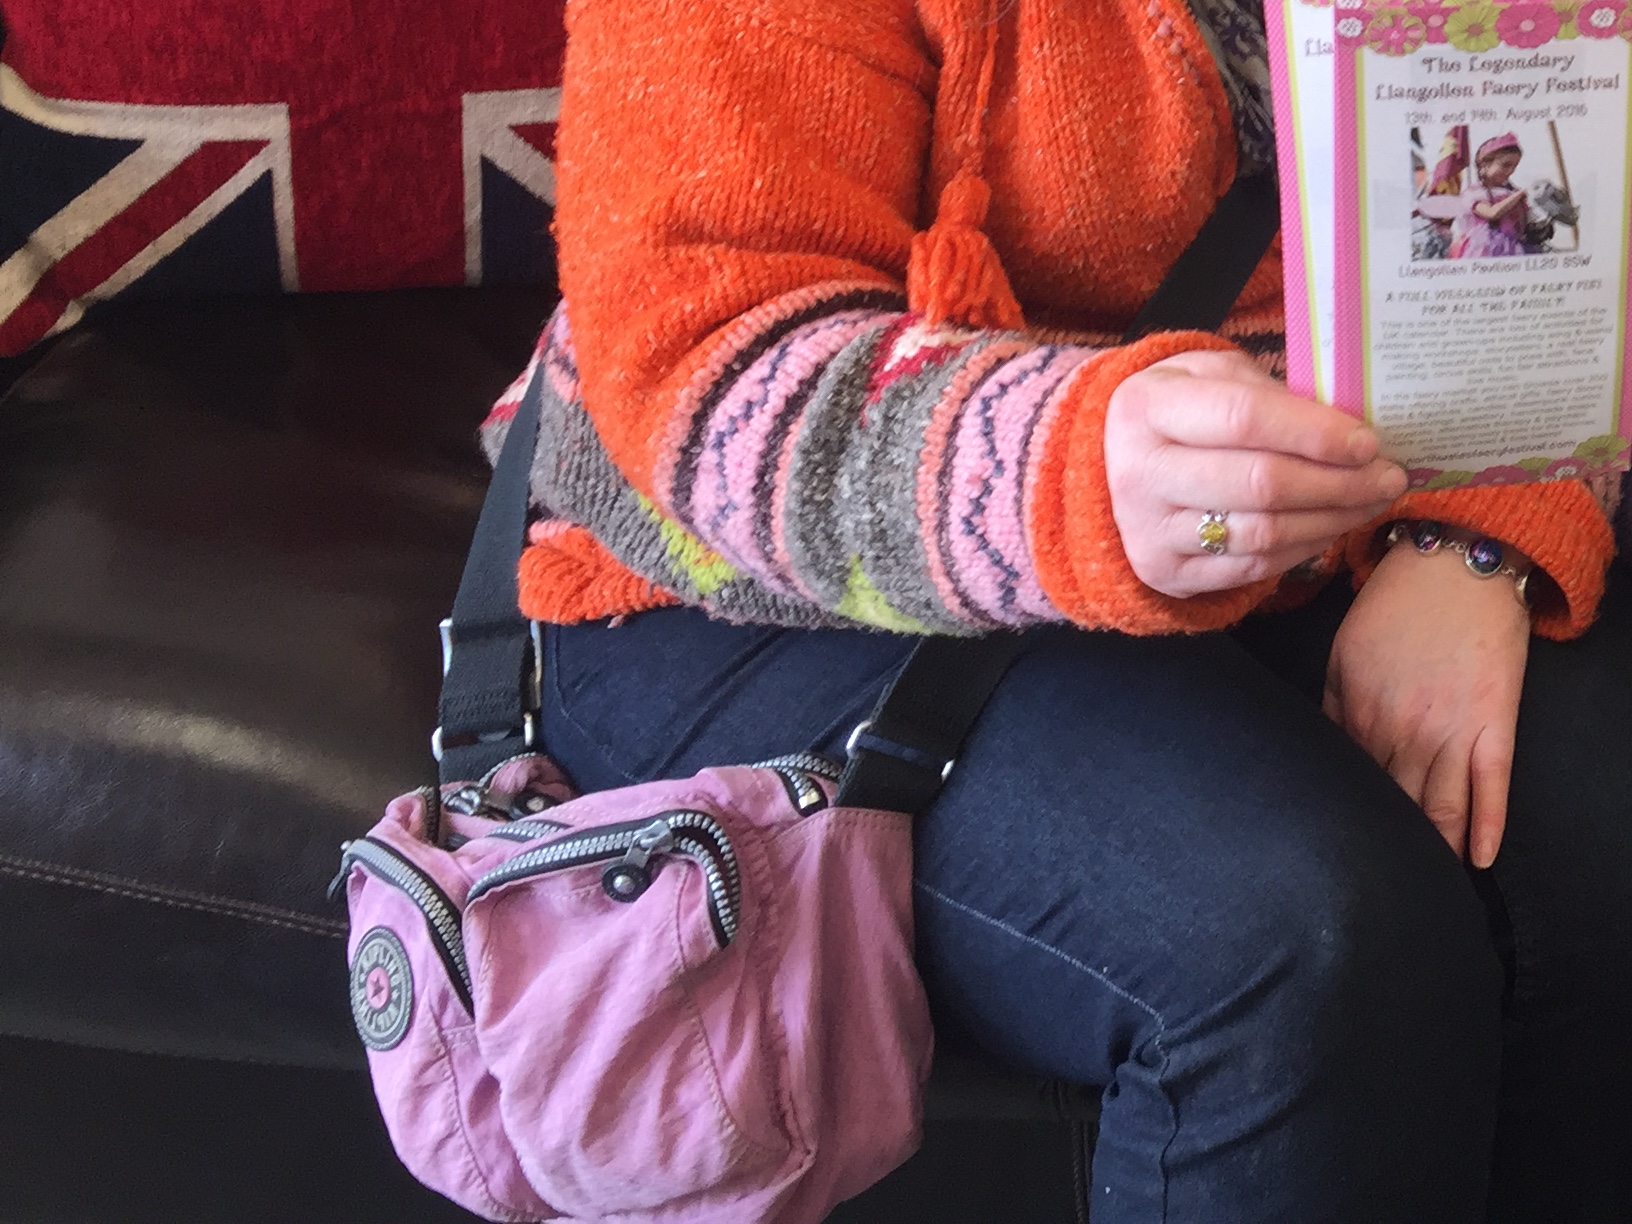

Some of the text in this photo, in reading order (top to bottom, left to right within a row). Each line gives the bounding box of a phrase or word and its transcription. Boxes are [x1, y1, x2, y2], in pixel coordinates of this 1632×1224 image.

[1422, 53, 1575, 74] The Legendary
[1375, 73, 1620, 102] Llangollen Faery Festival
[1440, 110, 1466, 123] and
[1505, 105, 1550, 122] August
[1399, 263, 1467, 280] Llangollen
[1472, 261, 1521, 275] Pavilion
